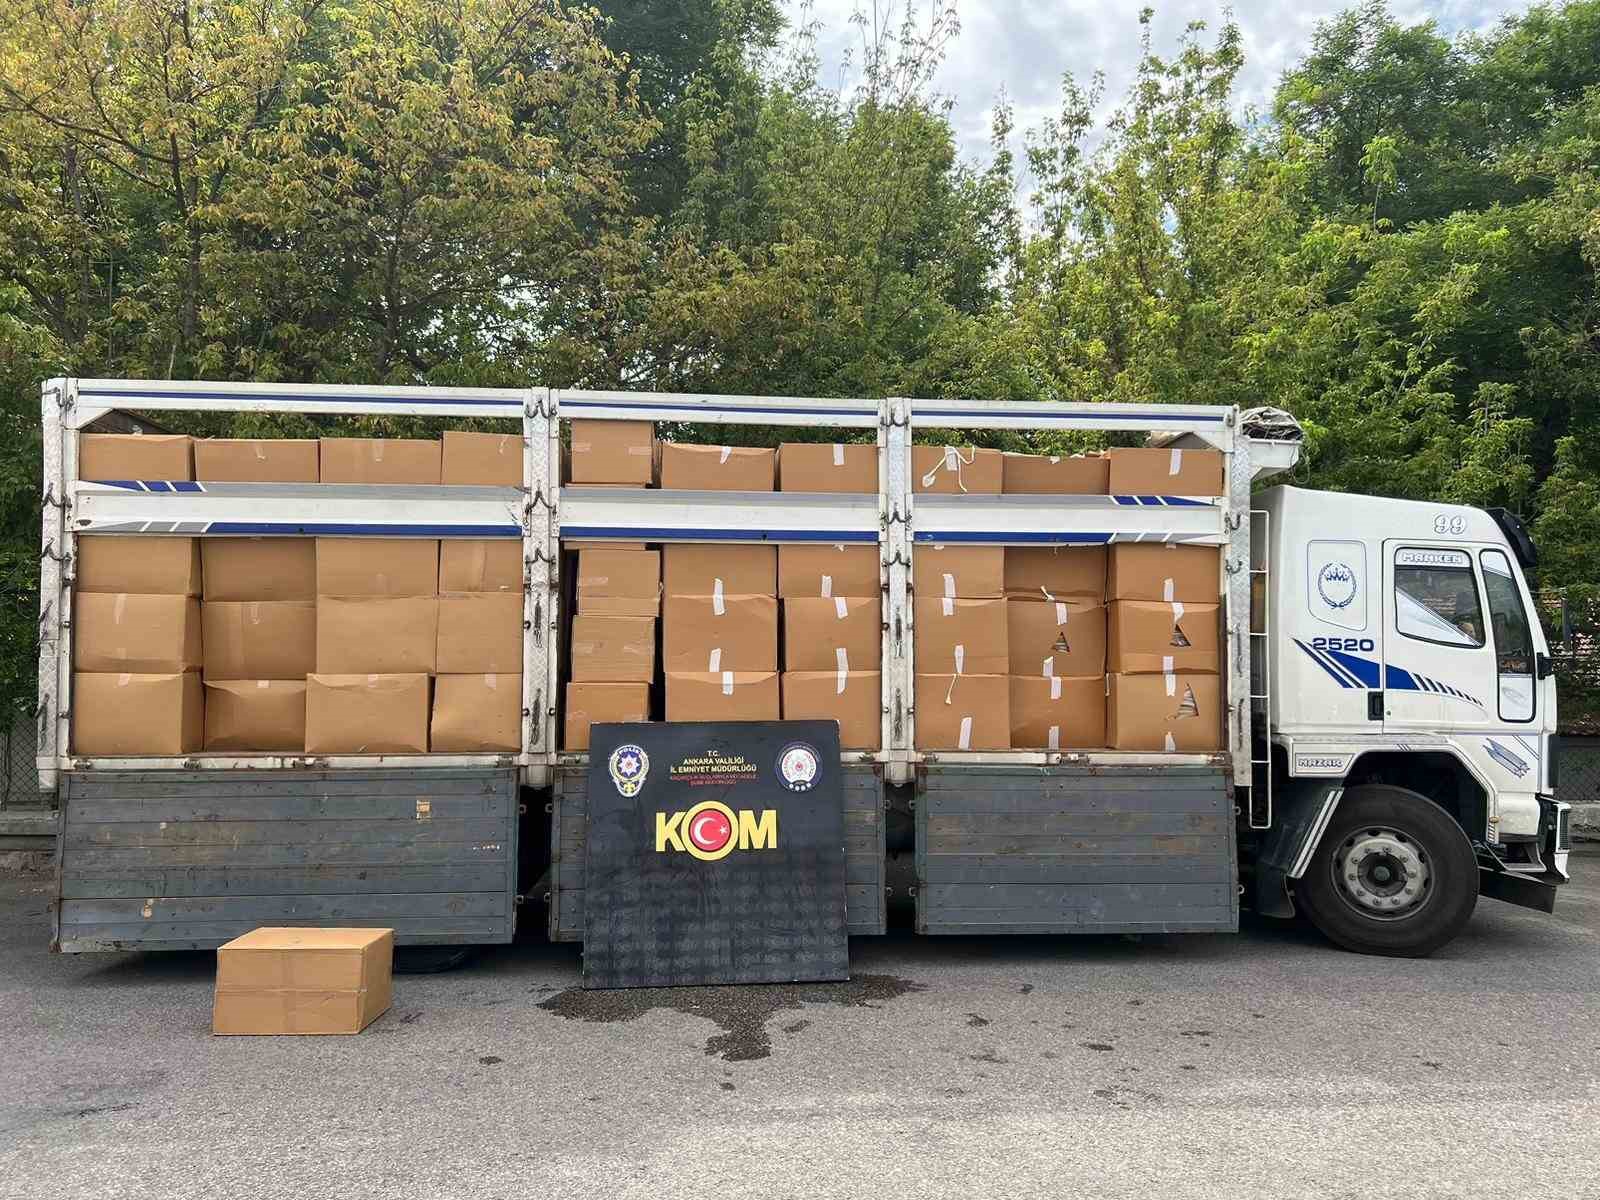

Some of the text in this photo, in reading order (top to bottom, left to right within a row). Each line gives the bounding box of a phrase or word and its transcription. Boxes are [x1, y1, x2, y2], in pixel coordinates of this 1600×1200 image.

[1433, 513, 1467, 534] 99
[1312, 637, 1375, 651] 2520
[683, 758, 713, 766] ANKARA
[656, 800, 777, 861] KOM
